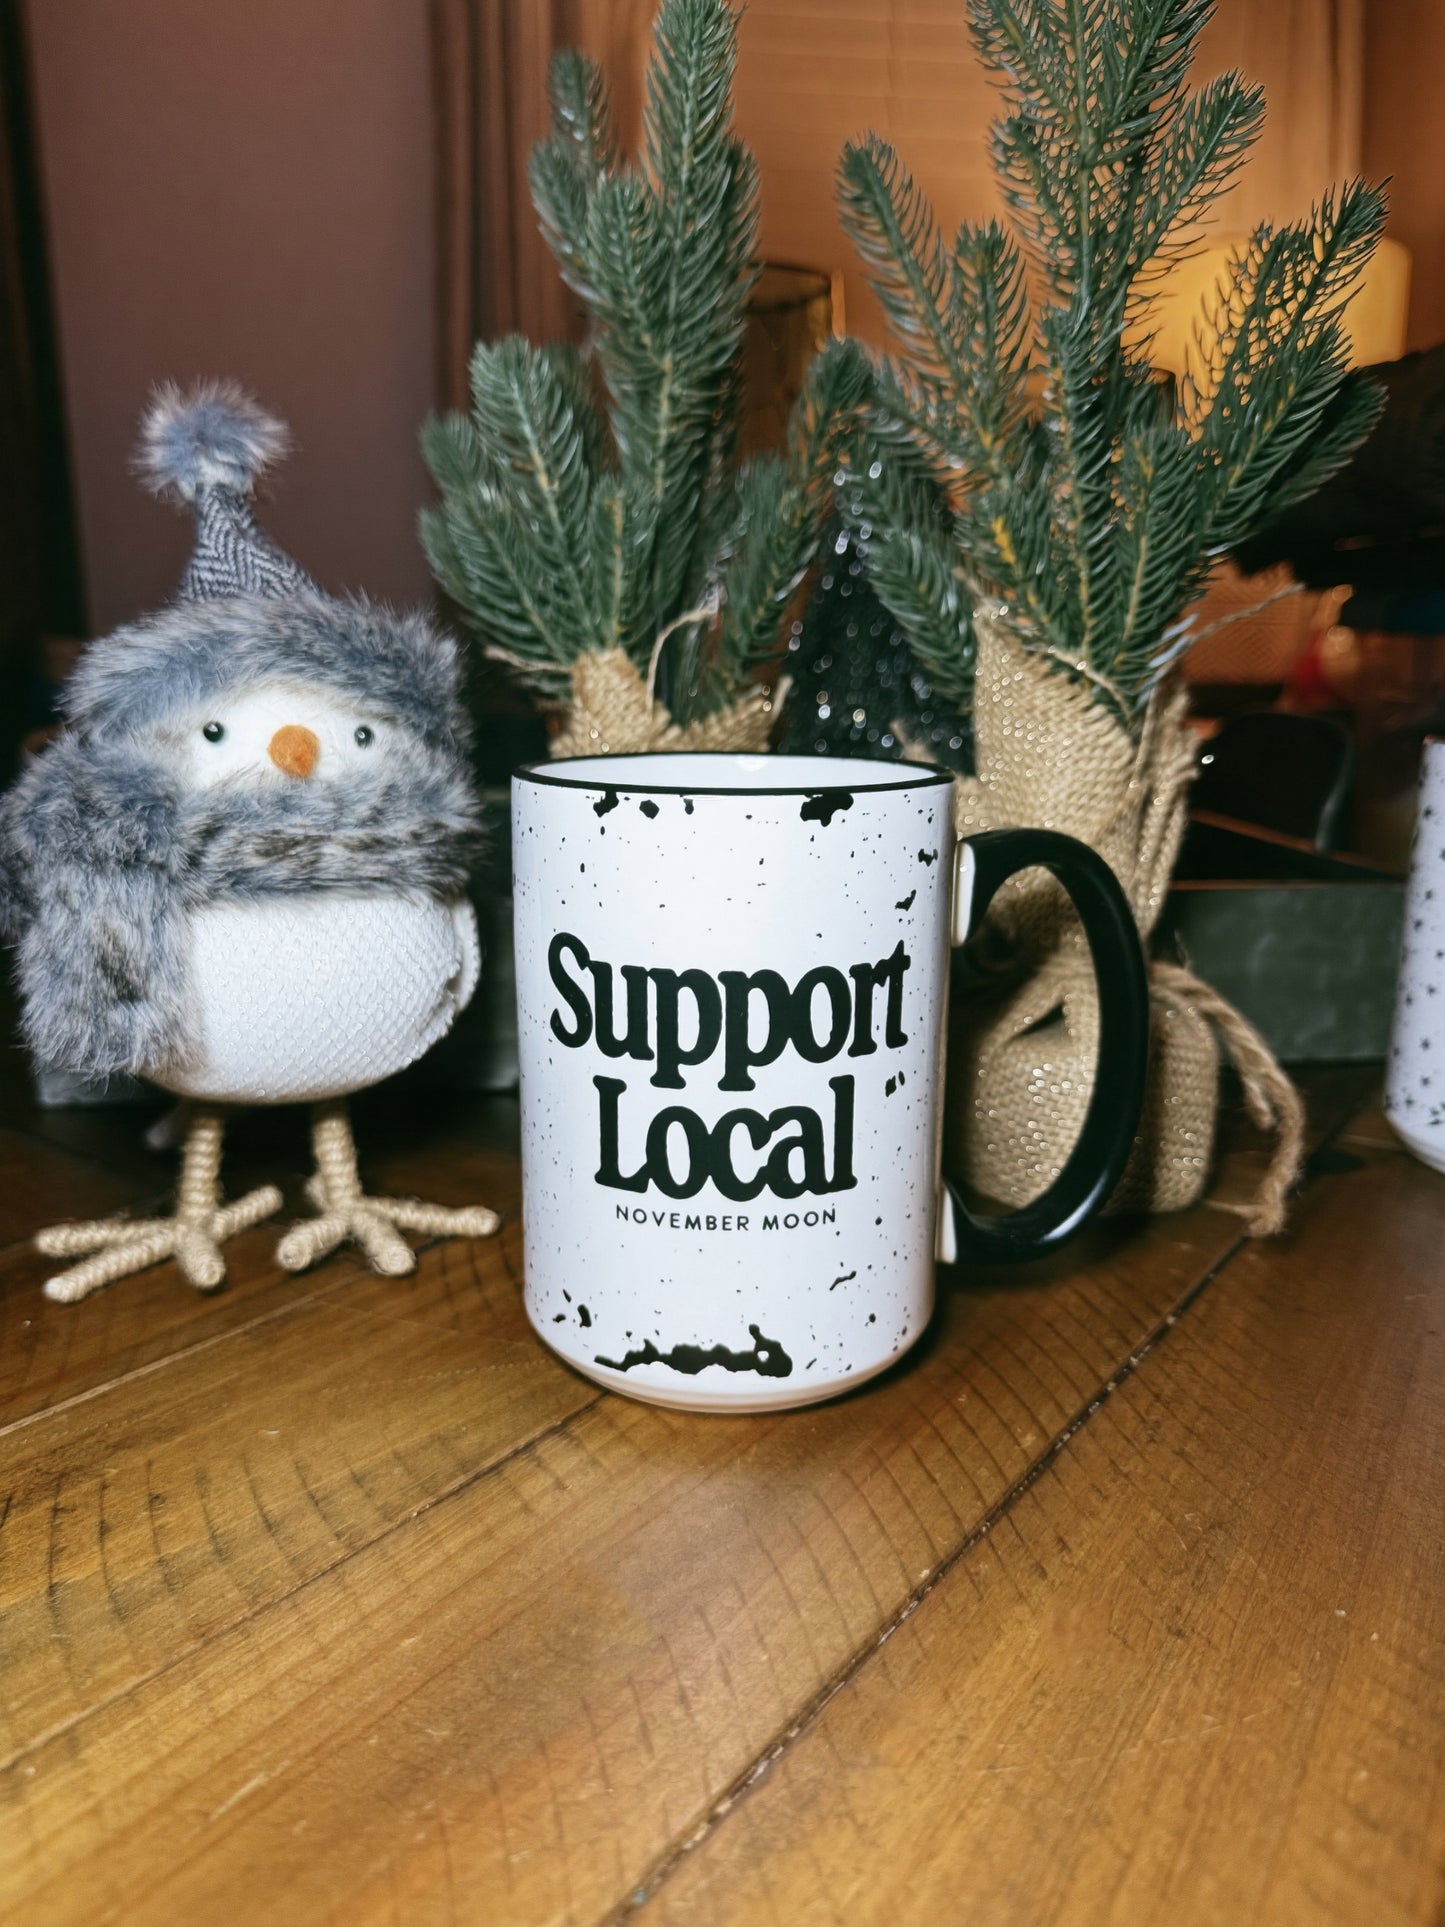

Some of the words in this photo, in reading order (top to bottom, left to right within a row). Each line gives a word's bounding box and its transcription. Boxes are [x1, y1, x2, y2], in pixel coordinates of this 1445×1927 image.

[547, 932, 912, 1092] Support
[592, 1074, 858, 1203] Local
[616, 1204, 749, 1231] NOVEMBER
[762, 1208, 836, 1231] MOON
